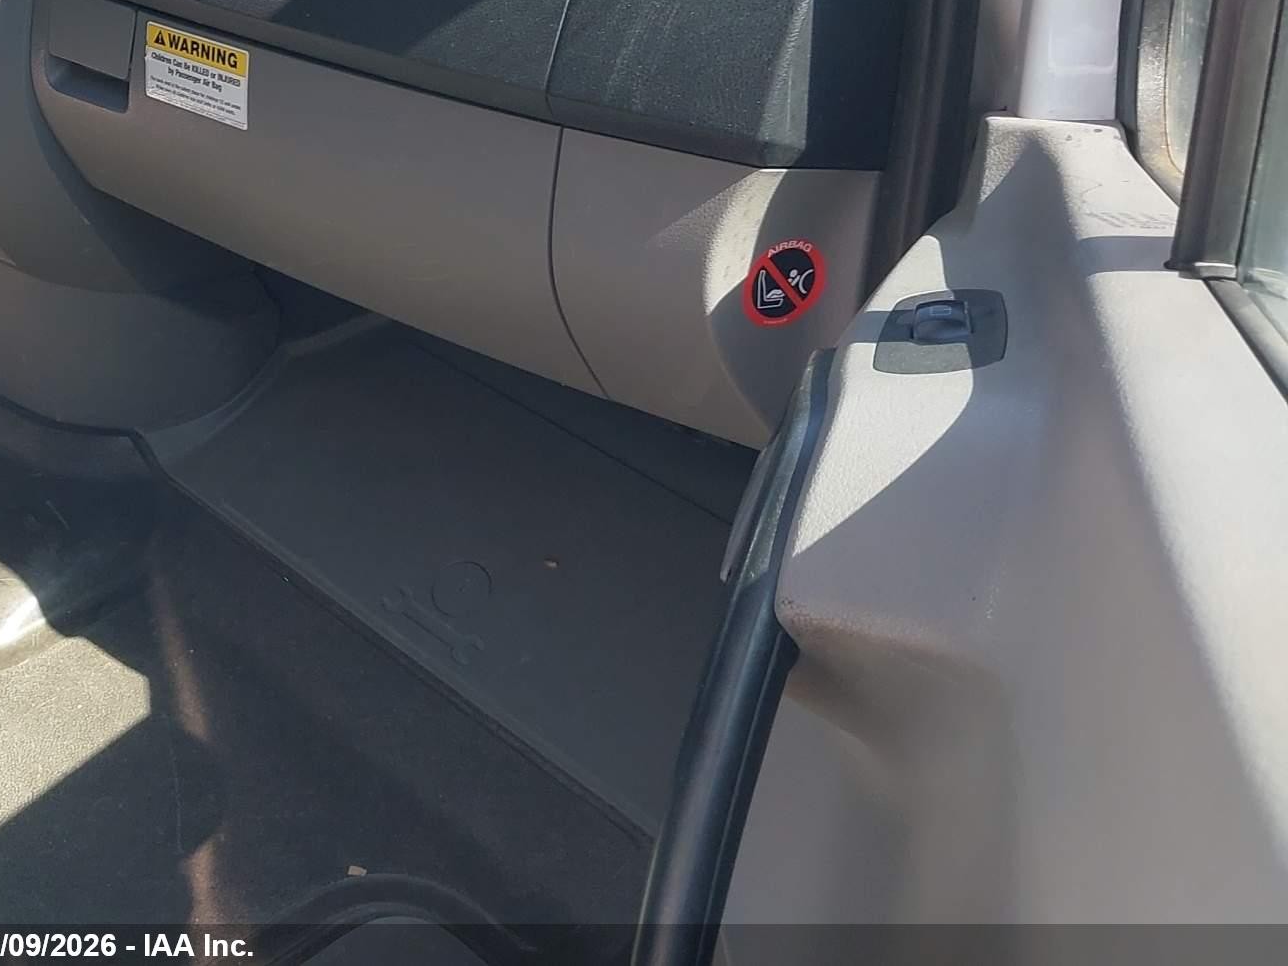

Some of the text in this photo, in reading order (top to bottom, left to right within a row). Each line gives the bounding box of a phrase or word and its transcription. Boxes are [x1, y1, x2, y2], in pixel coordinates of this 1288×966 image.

[168, 32, 238, 69] WARNING
[151, 52, 172, 66] Children
[173, 58, 183, 69] Can
[183, 61, 191, 71] Be
[191, 63, 210, 78] KILLED
[167, 66, 175, 77] by
[175, 69, 201, 85] Passenger
[768, 240, 812, 258] AIRBAG
